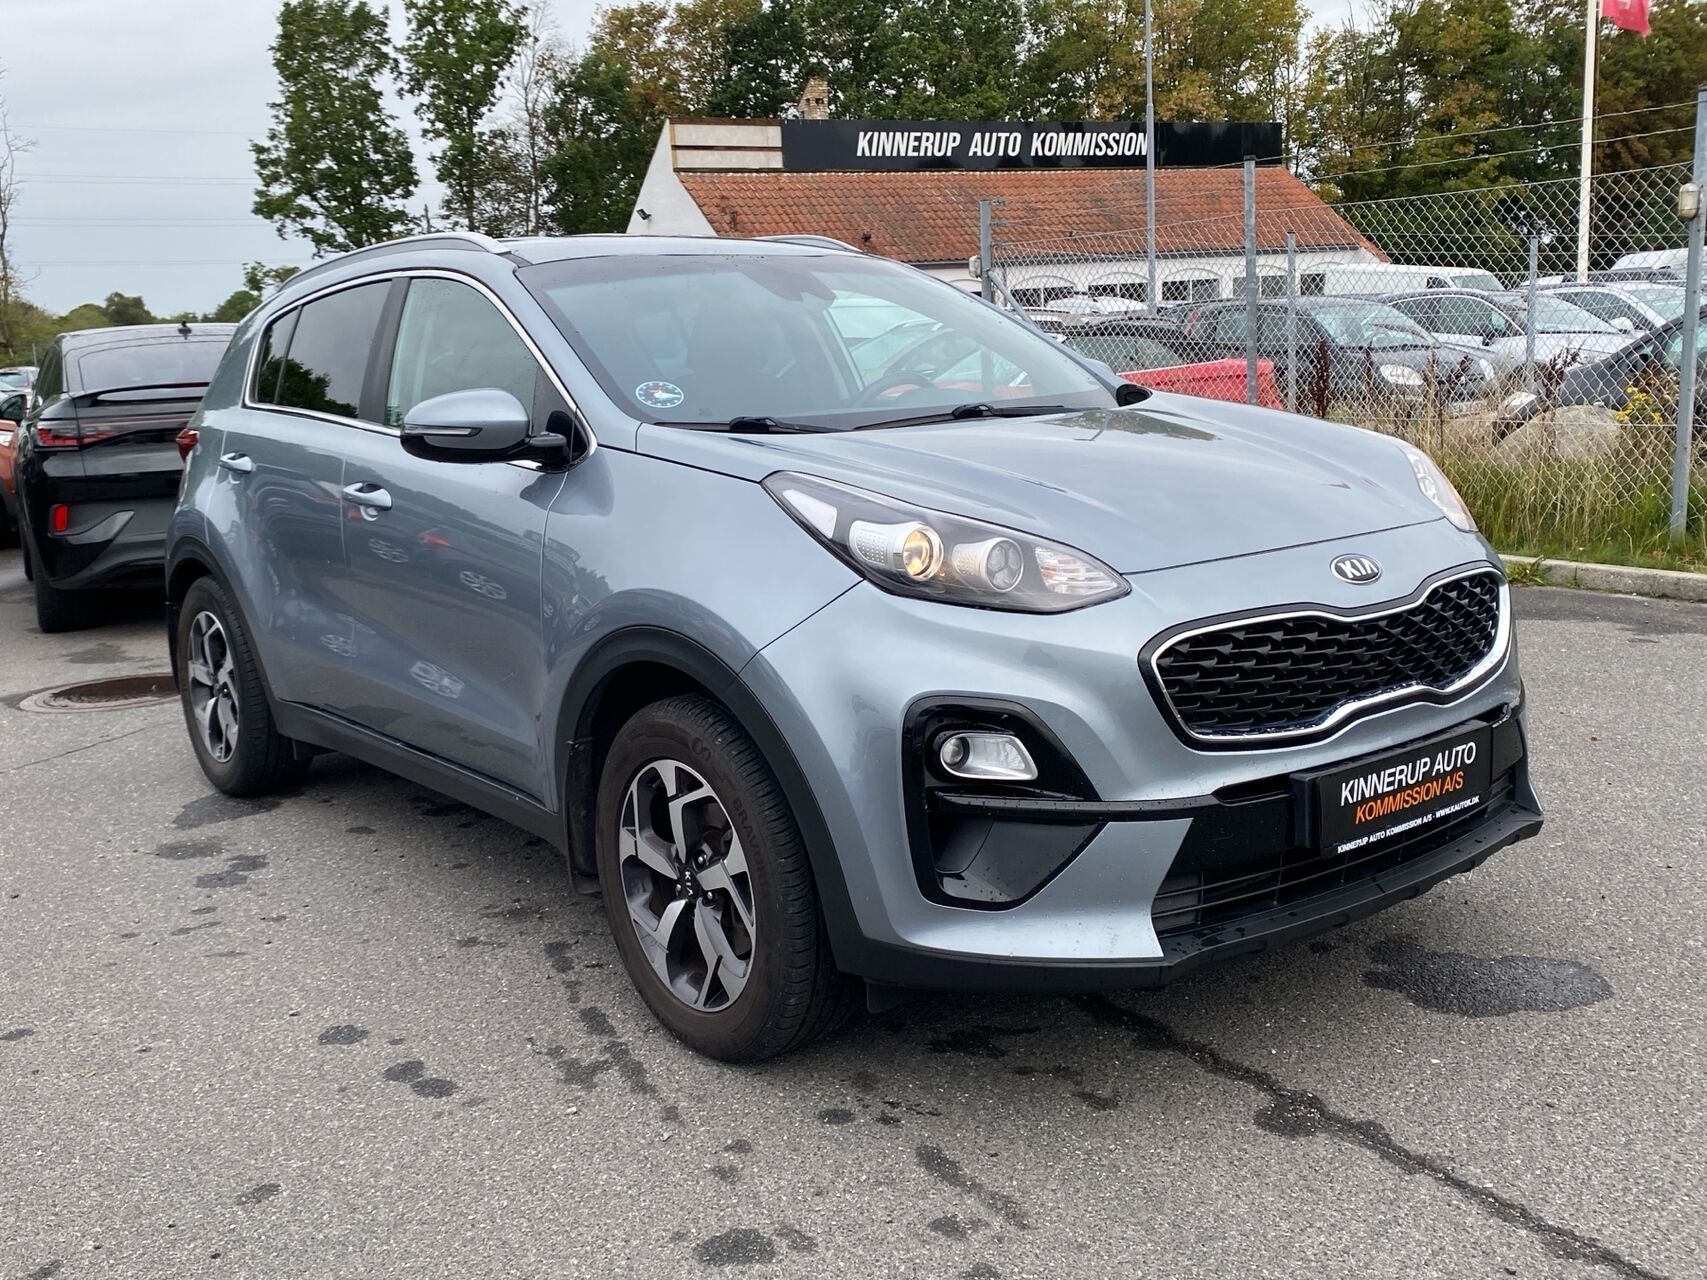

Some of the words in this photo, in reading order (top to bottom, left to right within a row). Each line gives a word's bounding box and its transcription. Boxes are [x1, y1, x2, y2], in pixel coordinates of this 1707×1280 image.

[856, 131, 961, 157] KINNERUP
[968, 131, 1022, 157] AUTO
[1030, 132, 1148, 156] KOMMISSION
[1337, 557, 1379, 579] KIA
[1340, 757, 1431, 807] KINNERUP
[1432, 741, 1477, 777] AUTO
[1355, 778, 1442, 825] KOMMISSION
[1442, 771, 1464, 795] A/S
[1337, 836, 1369, 854] KINNERUP
[1369, 830, 1386, 843] AUTO
[1386, 817, 1423, 837] KOMMISSION
[1422, 813, 1433, 825] A/S
[684, 871, 694, 896] KIA
